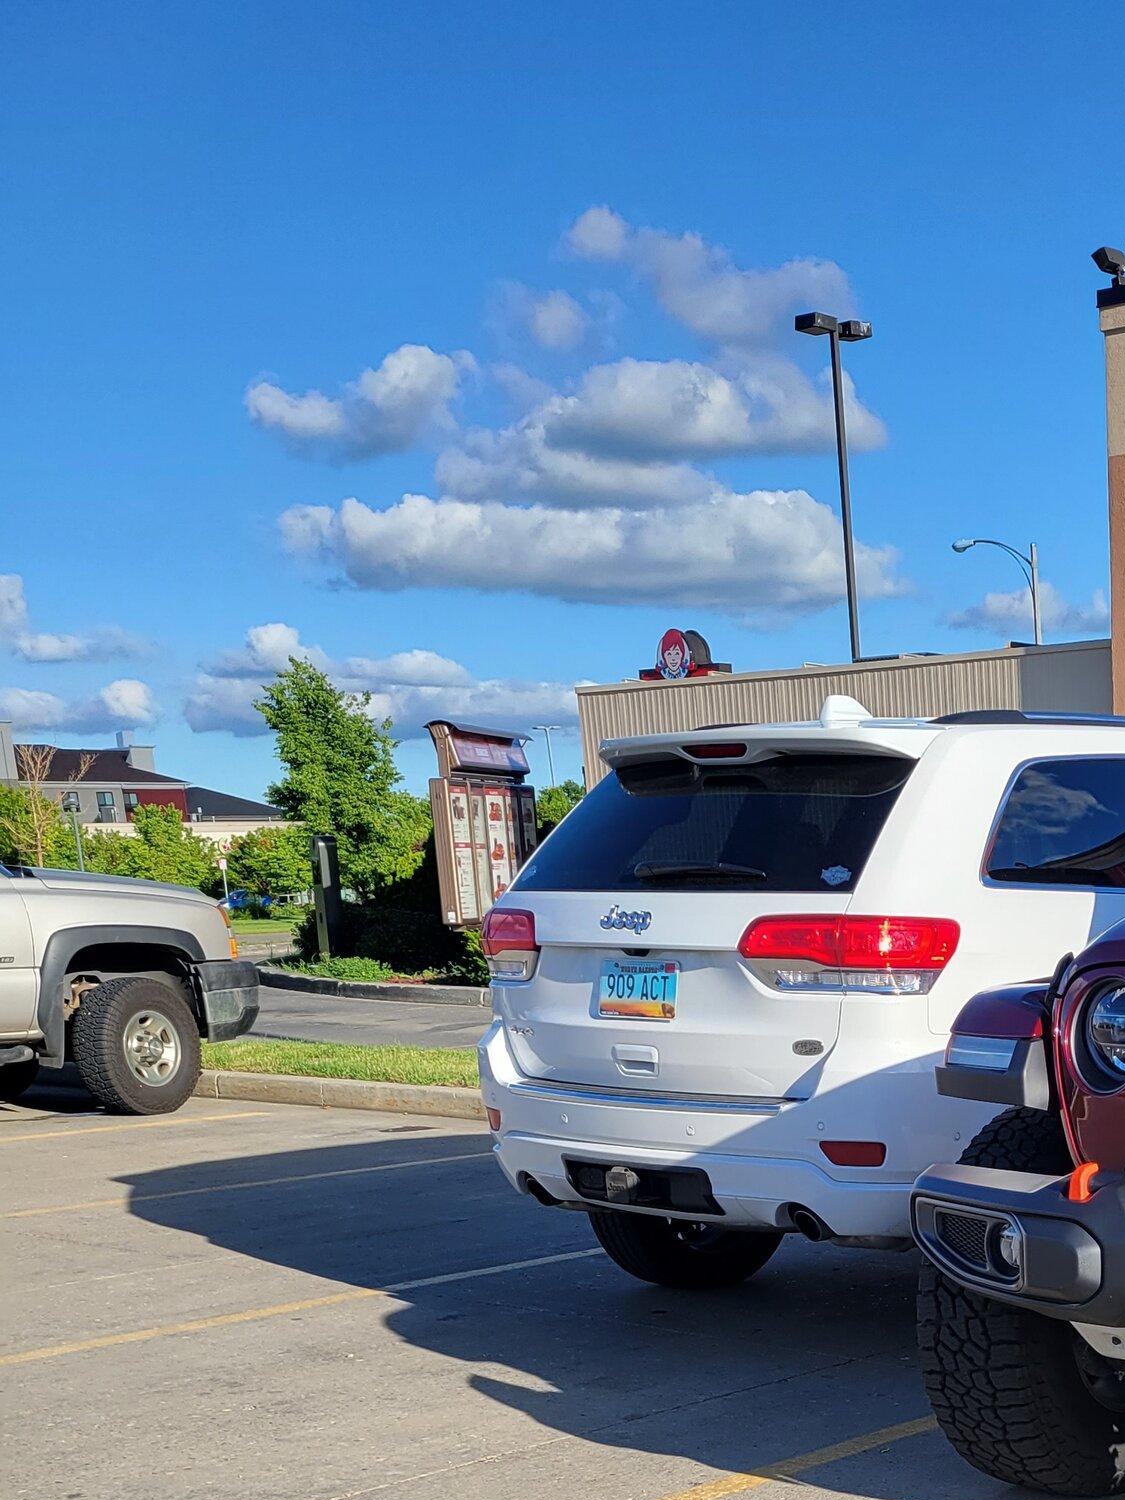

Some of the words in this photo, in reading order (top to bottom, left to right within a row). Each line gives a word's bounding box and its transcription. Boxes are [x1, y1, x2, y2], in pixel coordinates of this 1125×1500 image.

[600, 904, 652, 935] Jeep
[607, 973, 635, 999] 909
[640, 975, 669, 1002] ACT
